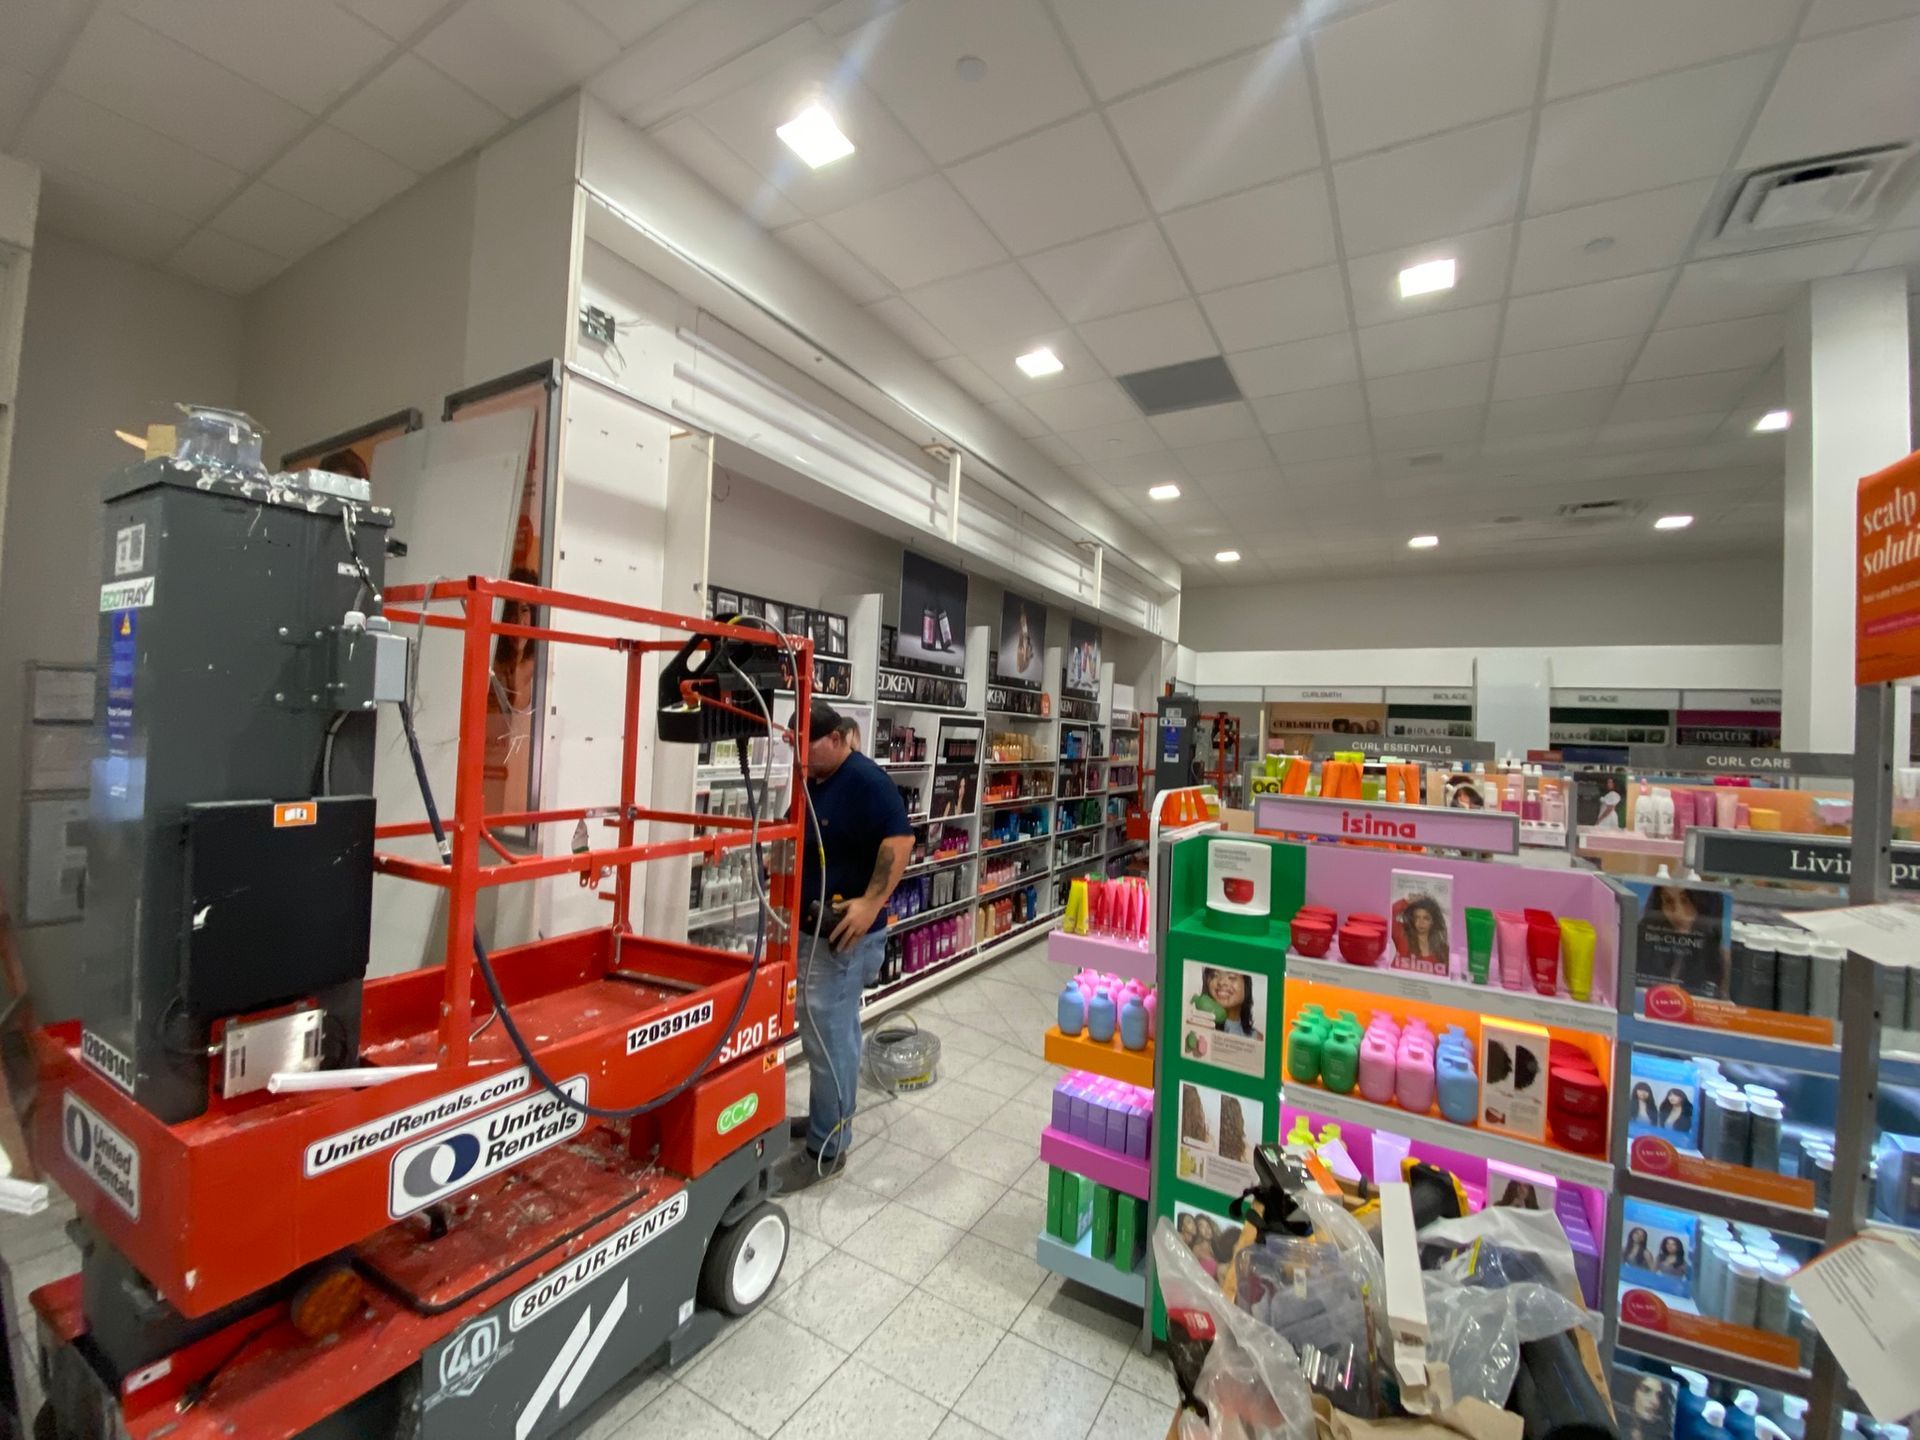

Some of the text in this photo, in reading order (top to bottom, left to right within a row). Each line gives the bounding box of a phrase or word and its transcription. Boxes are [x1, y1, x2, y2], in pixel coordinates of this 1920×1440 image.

[1863, 486, 1916, 536] scalp
[1273, 719, 1330, 730] CURLSMITH
[1352, 741, 1452, 754] CURL ESSENTIALS
[1696, 729, 1751, 741] matrix
[1706, 755, 1791, 769] CURL CARE
[1342, 811, 1417, 839] isima
[628, 1005, 711, 1050] 12039149
[719, 1021, 763, 1064] SJ20
[314, 1074, 525, 1168] UnitedRentals.com
[485, 1112, 578, 1168] Rentals
[93, 1124, 132, 1176] United
[94, 1153, 134, 1208] Rentals
[522, 1200, 680, 1318] 800-UR-RENTS
[447, 1326, 492, 1380] 40
